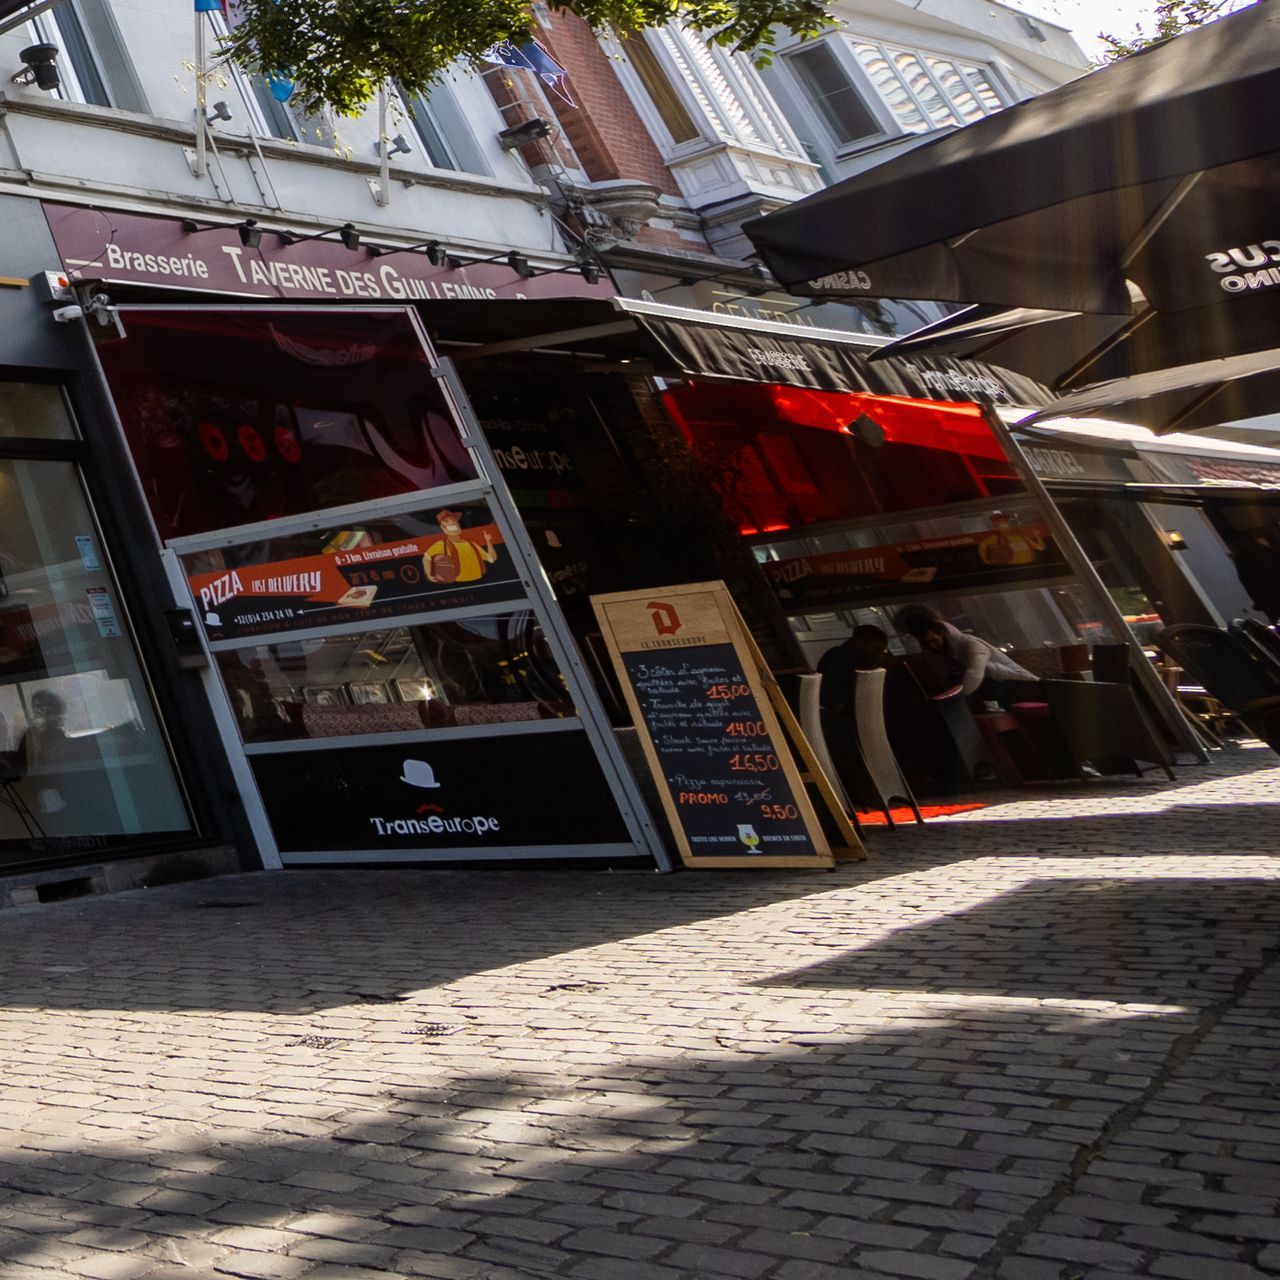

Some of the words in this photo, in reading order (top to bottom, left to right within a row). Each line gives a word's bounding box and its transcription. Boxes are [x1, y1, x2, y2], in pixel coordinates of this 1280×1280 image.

[106, 243, 209, 279] Brasserie
[338, 269, 381, 298] DES
[200, 570, 244, 610] PIZZA
[268, 571, 321, 593] DELIVERY
[637, 664, 649, 679] 3
[706, 684, 751, 700] 15,00
[680, 792, 729, 805] PROMO
[761, 804, 798, 820] 9,50
